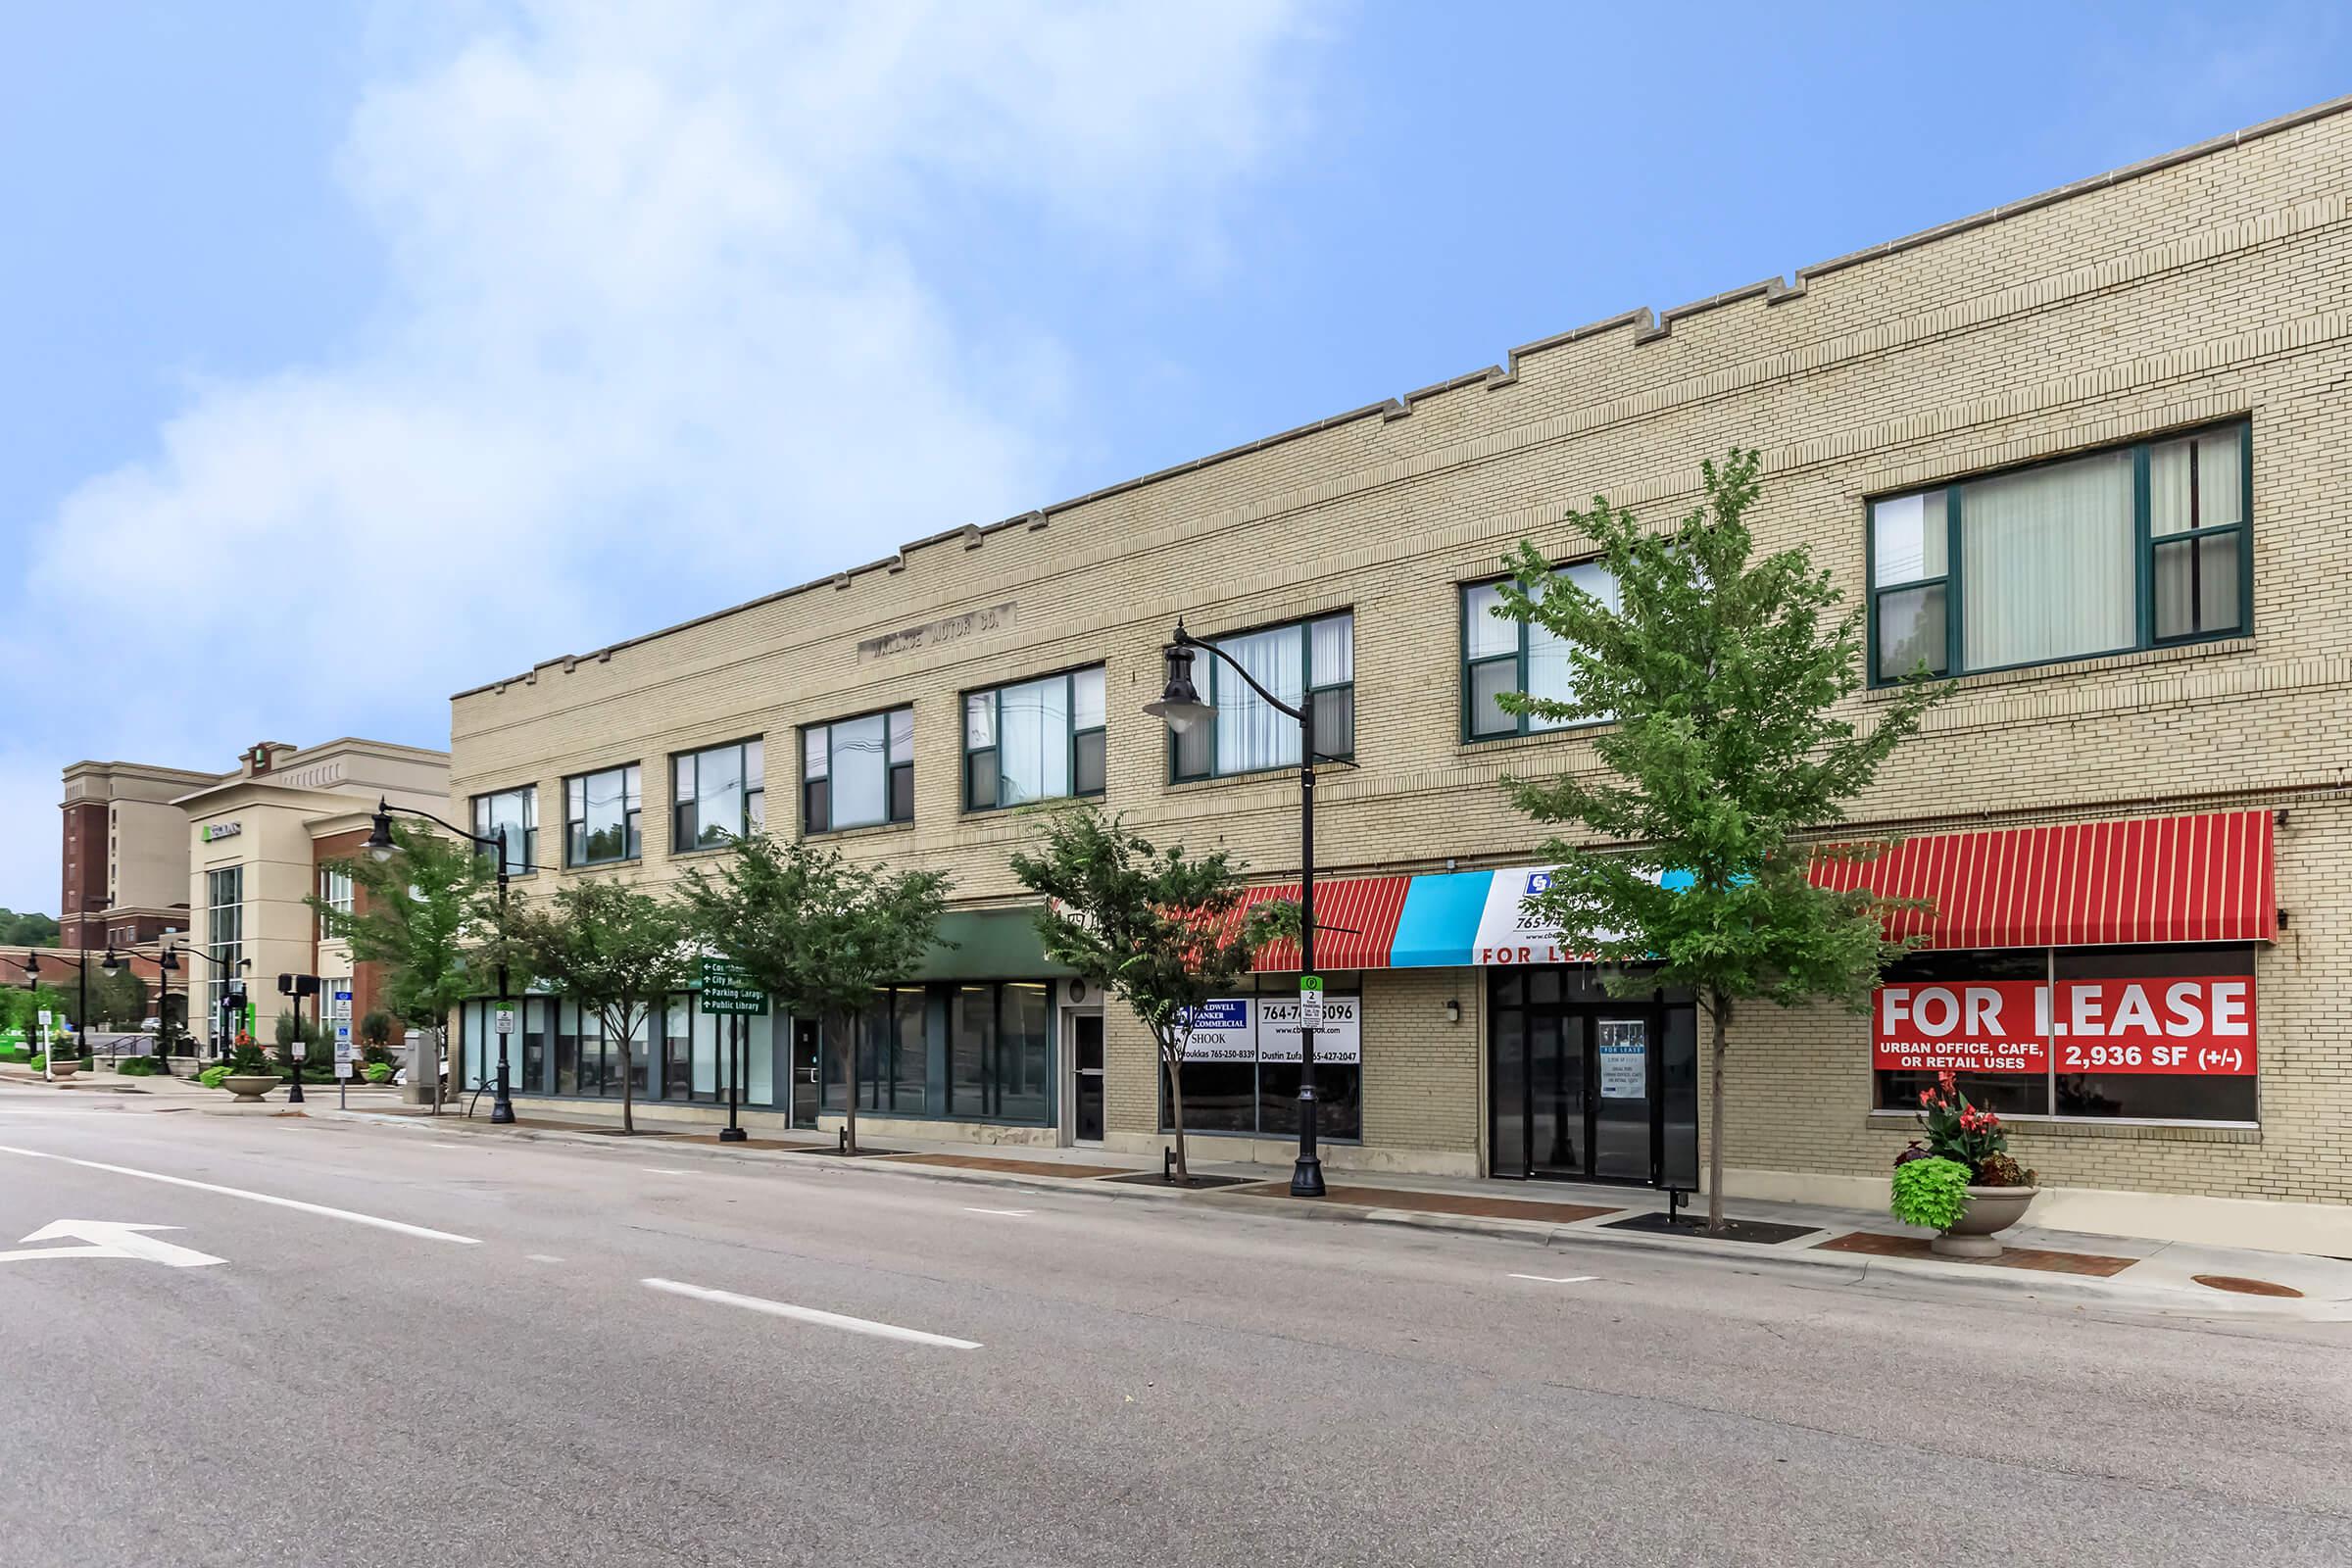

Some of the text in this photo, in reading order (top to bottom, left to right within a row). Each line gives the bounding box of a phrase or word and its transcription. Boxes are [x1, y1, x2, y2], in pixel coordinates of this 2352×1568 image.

[932, 616, 972, 644] MOTOR
[980, 611, 1000, 630] CO.
[1482, 947, 1531, 964] FOR
[711, 975, 725, 986] City
[711, 988, 739, 999] Parking
[1308, 991, 1315, 1000] 2
[711, 1001, 760, 1012] Public Library
[1883, 982, 2249, 1037] FOR LEASE
[1191, 1033, 1227, 1045] SHOOK
[1210, 1050, 1255, 1058] 765-250-8339
[1261, 1051, 1285, 1060] Dustin
[1312, 1052, 1357, 1060] 65-427-2047
[1881, 1042, 2044, 1057] URBAN OFFICE, CAFE,
[1901, 1056, 2026, 1069] OR RETAIL USES
[2065, 1046, 2243, 1071] 2,936 SF (+/-)
